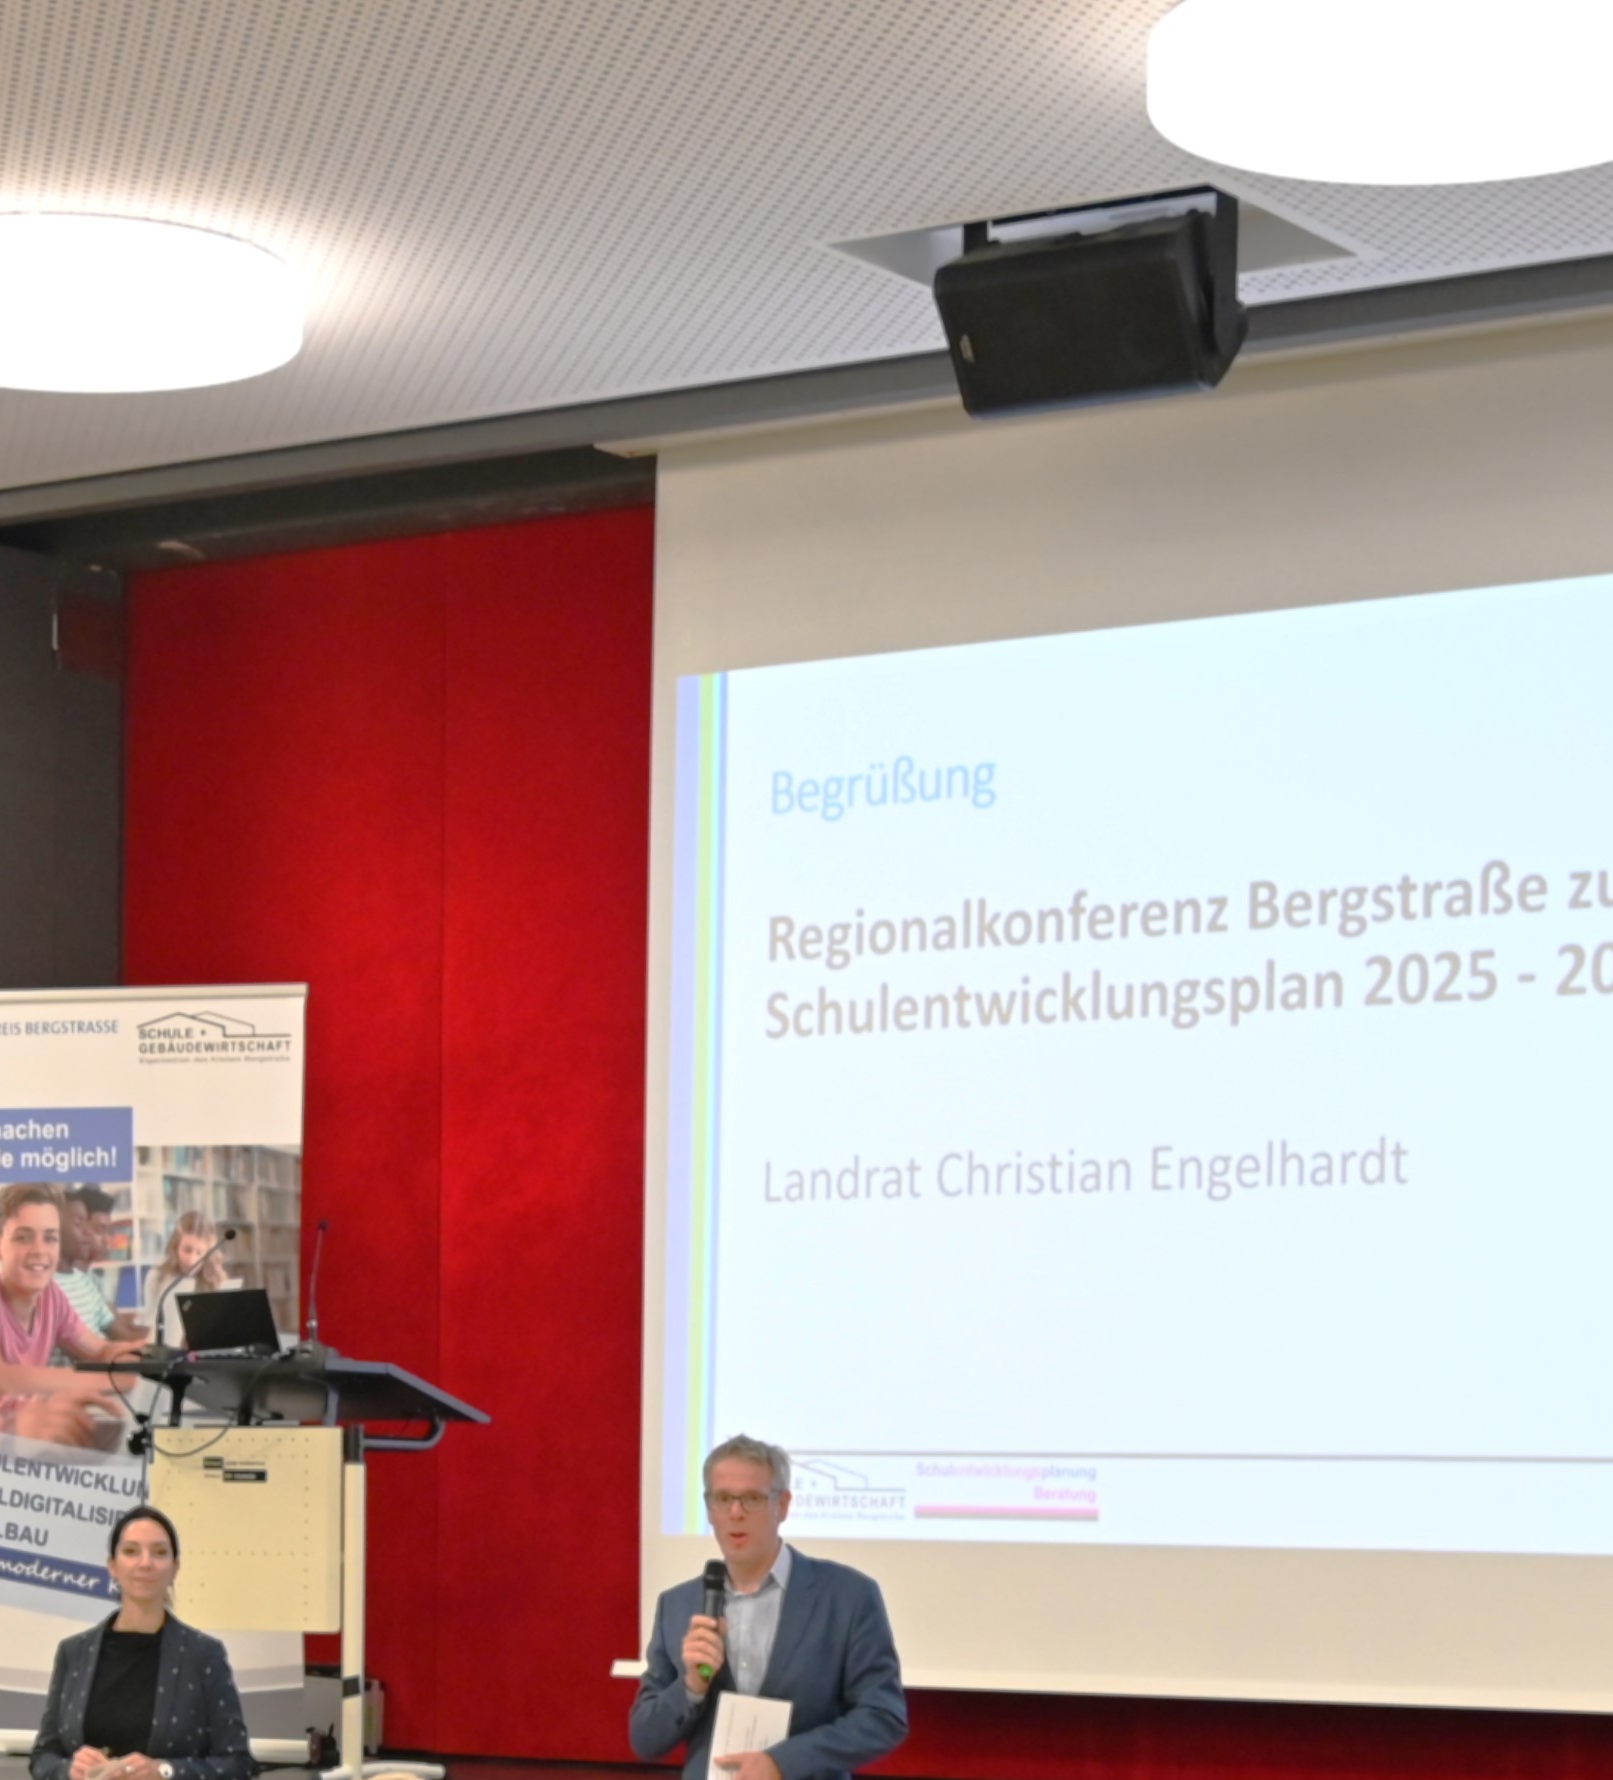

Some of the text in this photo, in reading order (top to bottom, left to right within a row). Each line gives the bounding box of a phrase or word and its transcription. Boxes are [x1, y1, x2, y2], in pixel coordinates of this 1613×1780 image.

[771, 755, 997, 822] Begrüßung
[768, 889, 1229, 971] Regionalkonferenz
[1248, 859, 1548, 938] Bergstraße
[766, 959, 1344, 1040] Schulentwicklungsplan
[1363, 949, 1498, 1007] 2025
[25, 1019, 119, 1035] BERGSTRASSE
[138, 1028, 193, 1039] SCHULE
[138, 1040, 292, 1054] GEBÄUDEWIRTSCHAFT
[21, 1146, 117, 1173] möglich!
[764, 1136, 1409, 1203] Landrat Christian Engelhardt
[1034, 1486, 1097, 1504] Beratung
